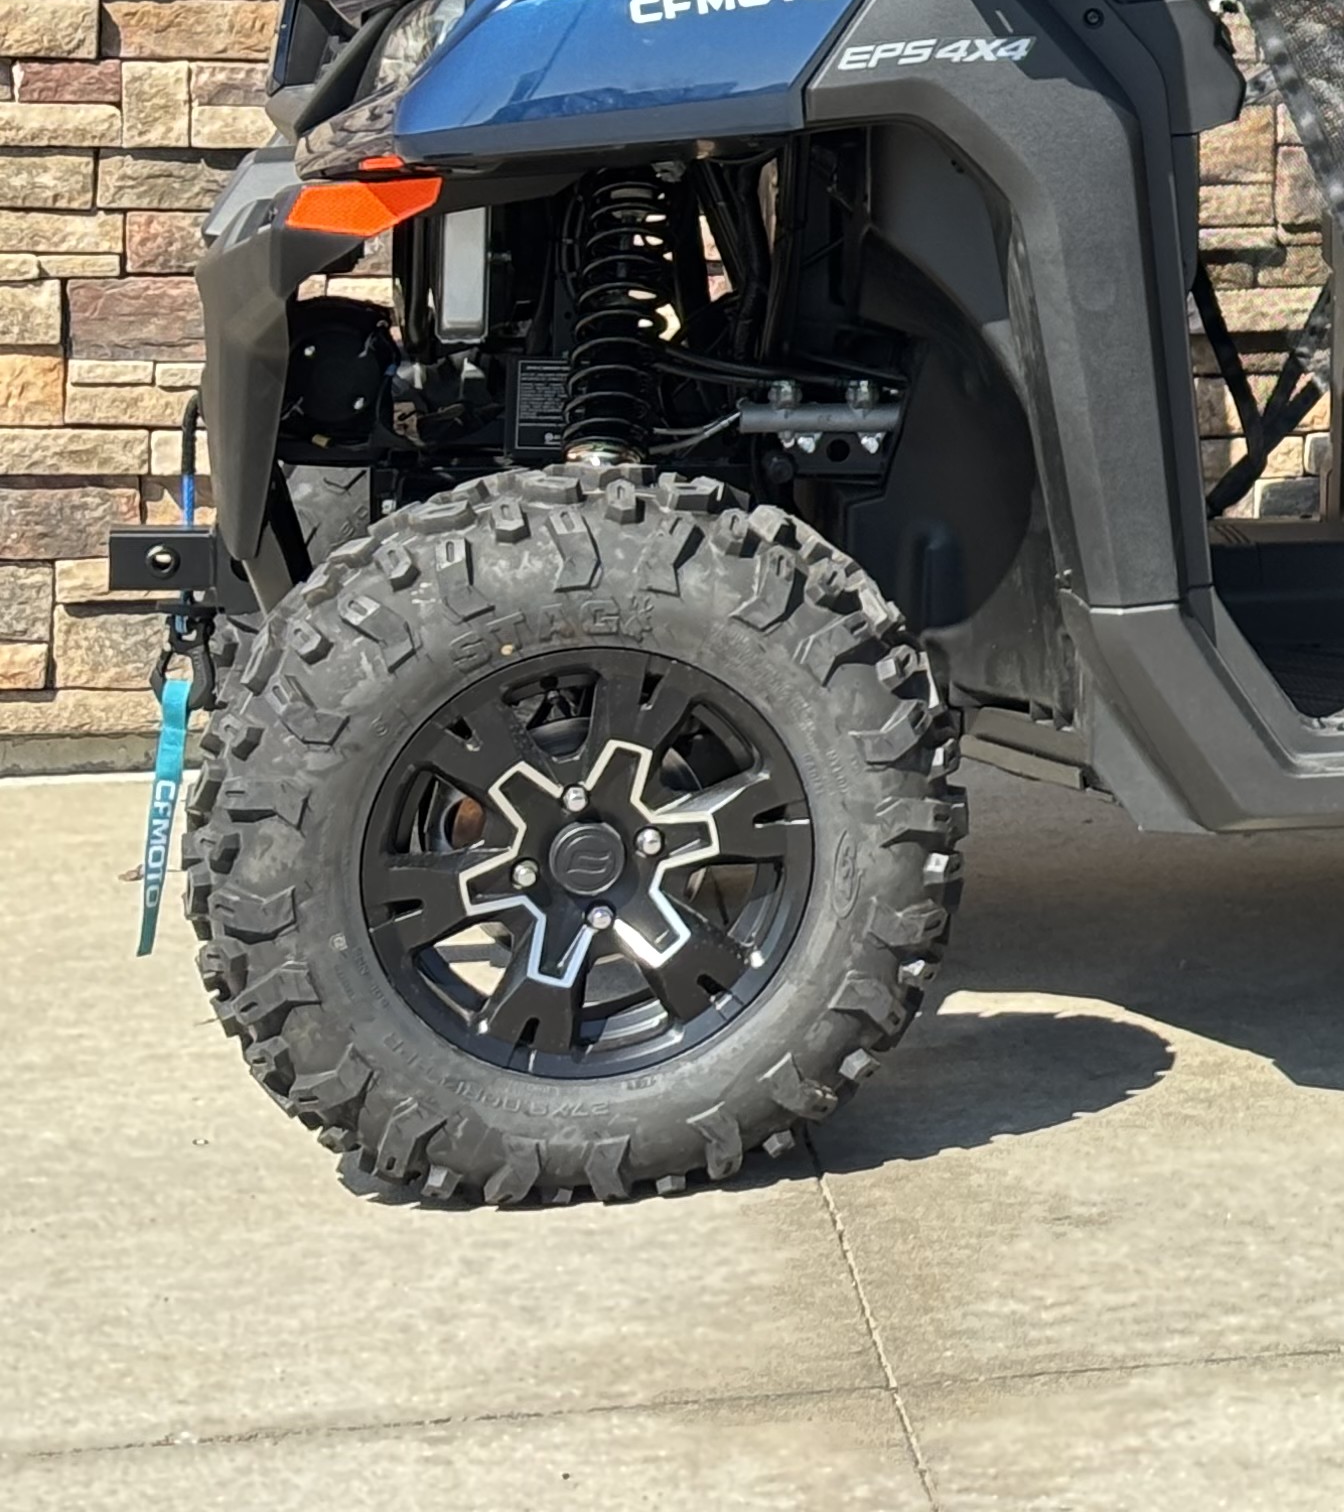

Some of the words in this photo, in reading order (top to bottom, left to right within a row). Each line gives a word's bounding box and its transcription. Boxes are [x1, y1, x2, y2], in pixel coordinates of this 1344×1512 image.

[837, 39, 938, 71] EPS
[934, 37, 1031, 63] 4X4
[450, 599, 620, 674] STAG
[144, 779, 177, 908] CFMOTO
